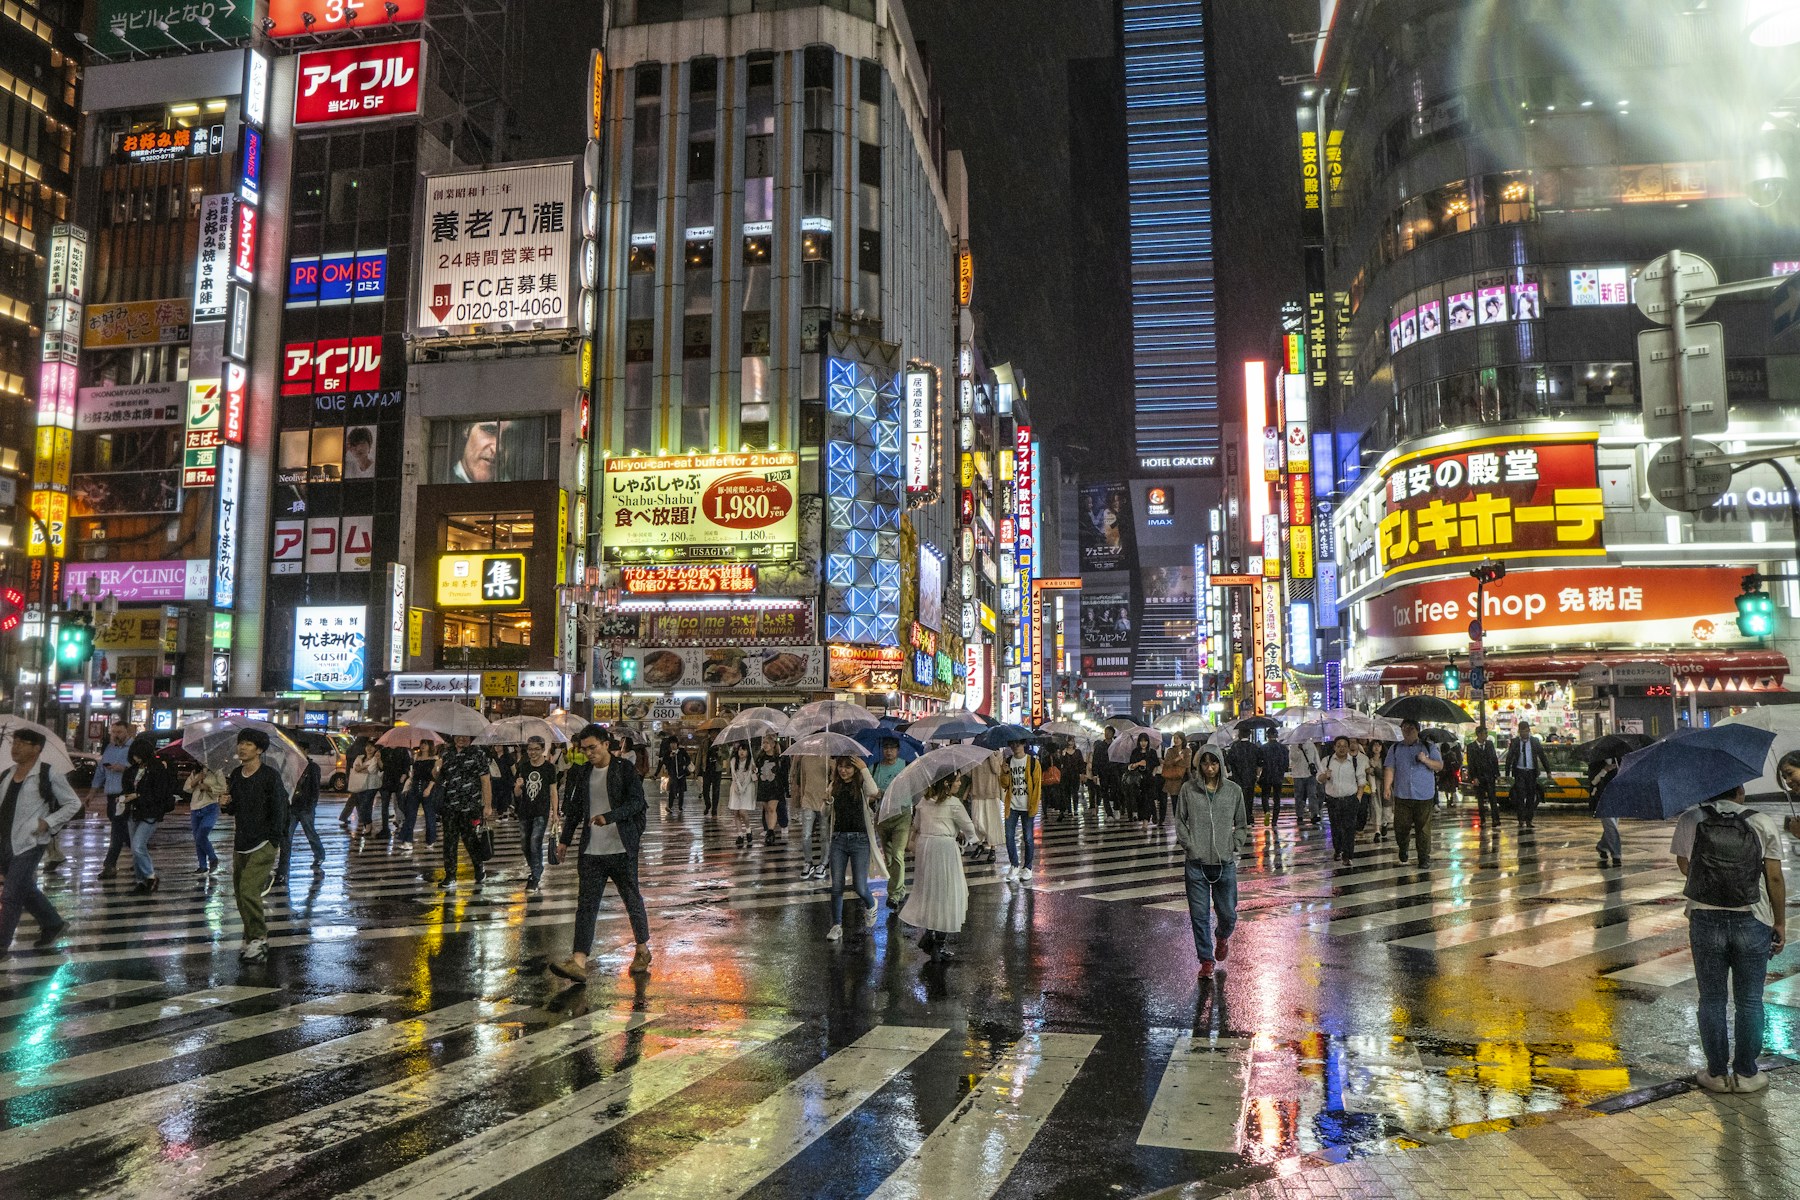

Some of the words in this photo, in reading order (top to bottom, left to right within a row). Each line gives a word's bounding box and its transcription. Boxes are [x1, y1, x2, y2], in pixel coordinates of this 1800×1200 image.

[303, 57, 414, 97] アイフル
[327, 99, 360, 113] 当ビル
[363, 95, 384, 110] 5F
[123, 129, 191, 152] お好み焼
[211, 135, 222, 146] 8F
[247, 133, 257, 178] PROMISE
[1301, 131, 1319, 209] 驚安の殿堂
[433, 183, 512, 201] 創業昭和十三年
[431, 201, 564, 243] 養老乃瀧
[240, 220, 252, 270] アイフル
[199, 208, 219, 305] お好み焼き本陣
[438, 245, 554, 269] 24時間営業中
[295, 260, 383, 285] PROMISE
[462, 273, 558, 299] FC店募集
[1600, 283, 1626, 303] 新宿
[434, 295, 449, 307] B1
[456, 296, 562, 321] 0120-81-4060
[89, 306, 128, 330] お好み
[154, 303, 186, 325] 焼き
[126, 322, 153, 340] たこ
[287, 345, 382, 377] アイフル
[91, 388, 141, 399] OKONOMIYAKI
[323, 378, 340, 390] 5F
[228, 393, 240, 431] アコム
[912, 377, 923, 429] 居酒屋食堂
[82, 407, 153, 423] お好み焼き本陣
[188, 431, 223, 447] たばこ
[196, 450, 214, 466] 酒
[609, 457, 692, 471] All-you-can-eat
[694, 456, 729, 468] buffet
[731, 455, 747, 465] for
[750, 455, 759, 465] 2
[761, 453, 794, 465] hours
[1141, 458, 1171, 467] HOTEL
[1172, 457, 1215, 466] GRACERY
[279, 473, 306, 483] Neolive
[613, 473, 701, 494] しゃぶしゃぶ
[1017, 430, 1031, 531] カラオケ歌広場
[1391, 449, 1540, 502] 驚安の殿堂
[614, 506, 696, 527] 食べ放題!
[713, 494, 770, 523] 1,980
[770, 509, 785, 518] yen
[274, 525, 372, 558] アコム
[660, 531, 686, 543] 2,480
[739, 529, 765, 542] 1,480
[772, 543, 793, 556] 5F
[131, 568, 185, 584] CLINIC
[483, 560, 519, 598] 集
[1392, 604, 1410, 628] Tax
[1414, 598, 1459, 623] Free
[1467, 590, 1547, 621] Shop
[1556, 586, 1644, 613] 免税店
[27, 612, 38, 620] 8F
[658, 614, 726, 629] Welcome
[730, 612, 795, 627] お好み焼き
[1033, 600, 1041, 666] GODZILLA
[832, 649, 879, 659] OKONOMI
[881, 650, 904, 659] YAKI
[1096, 656, 1129, 666] MARUHAN
[1264, 641, 1282, 680] 金の蔵
[967, 647, 976, 687] トラノコ
[423, 677, 446, 690] Roko
[501, 675, 515, 693] 集
[1033, 674, 1041, 706] ROAD
